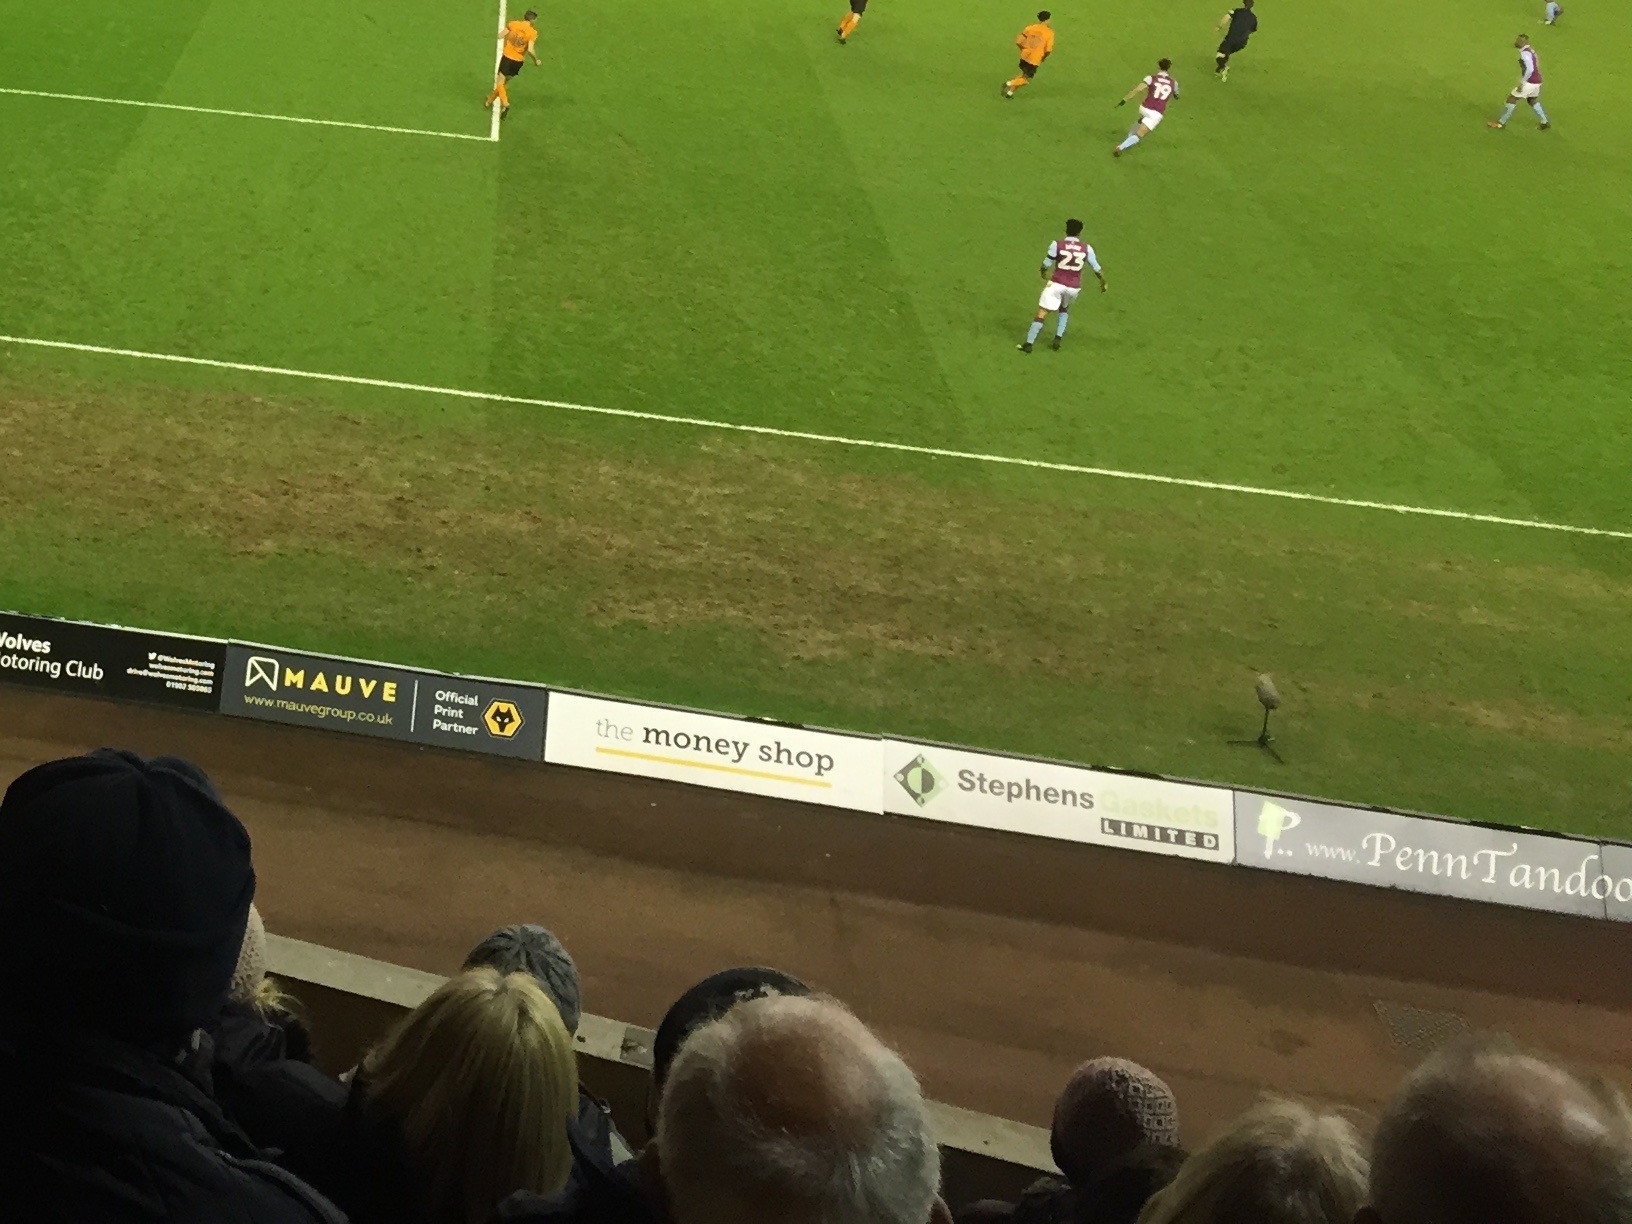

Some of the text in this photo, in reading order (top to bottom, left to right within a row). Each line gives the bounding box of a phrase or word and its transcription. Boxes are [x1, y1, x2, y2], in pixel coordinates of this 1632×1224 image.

[1153, 81, 1172, 101] 19
[1057, 249, 1087, 272] 23
[66, 659, 104, 680] Club
[284, 667, 398, 703] MAUVE
[244, 694, 393, 726] www.mauvegroup.co.uk
[435, 690, 479, 707] Official
[434, 704, 463, 719] Print
[432, 718, 478, 736] Partner
[596, 718, 834, 776] the money shop
[957, 768, 1219, 832] Stephens Gaskets
[1102, 818, 1218, 849] LIMITED
